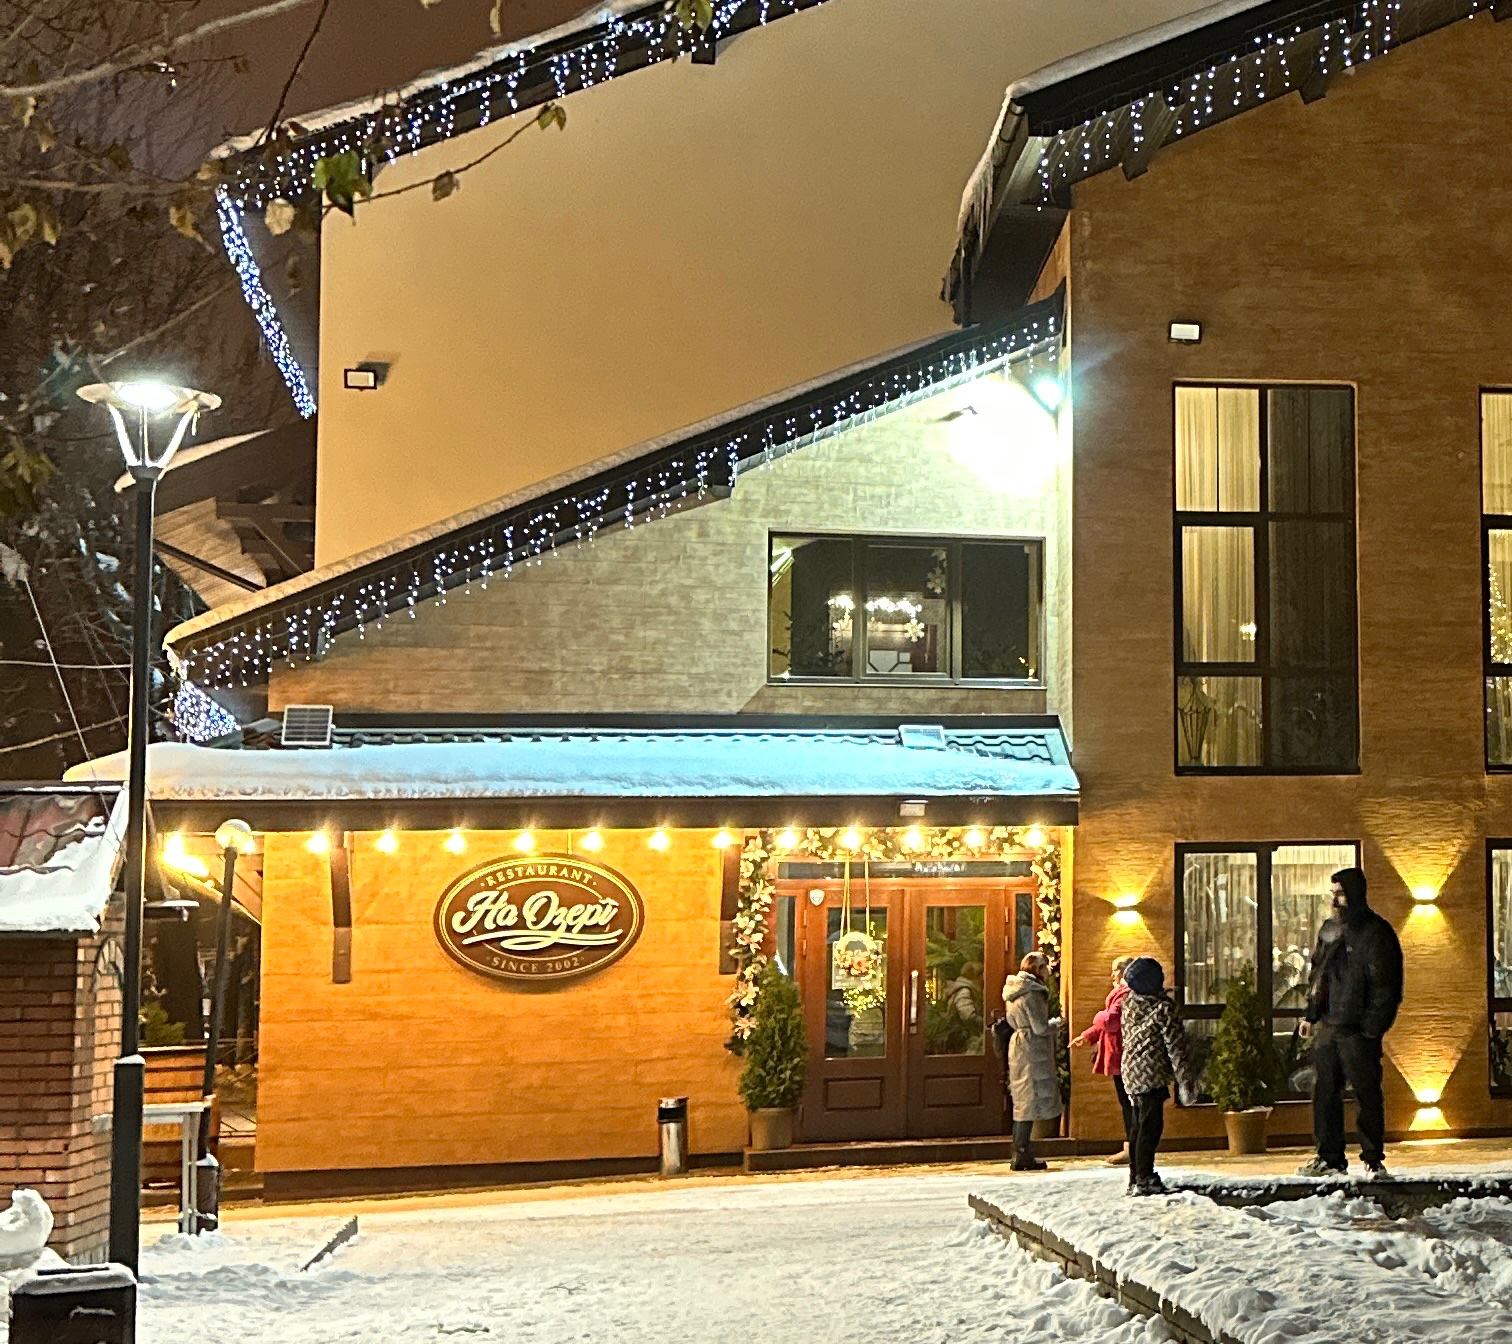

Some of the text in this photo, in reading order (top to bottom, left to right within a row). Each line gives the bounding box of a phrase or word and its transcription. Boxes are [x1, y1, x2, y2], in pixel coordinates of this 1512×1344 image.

[486, 865, 591, 886] RESTAURANT
[451, 891, 518, 933] На
[491, 957, 581, 973] SINCE 2002
